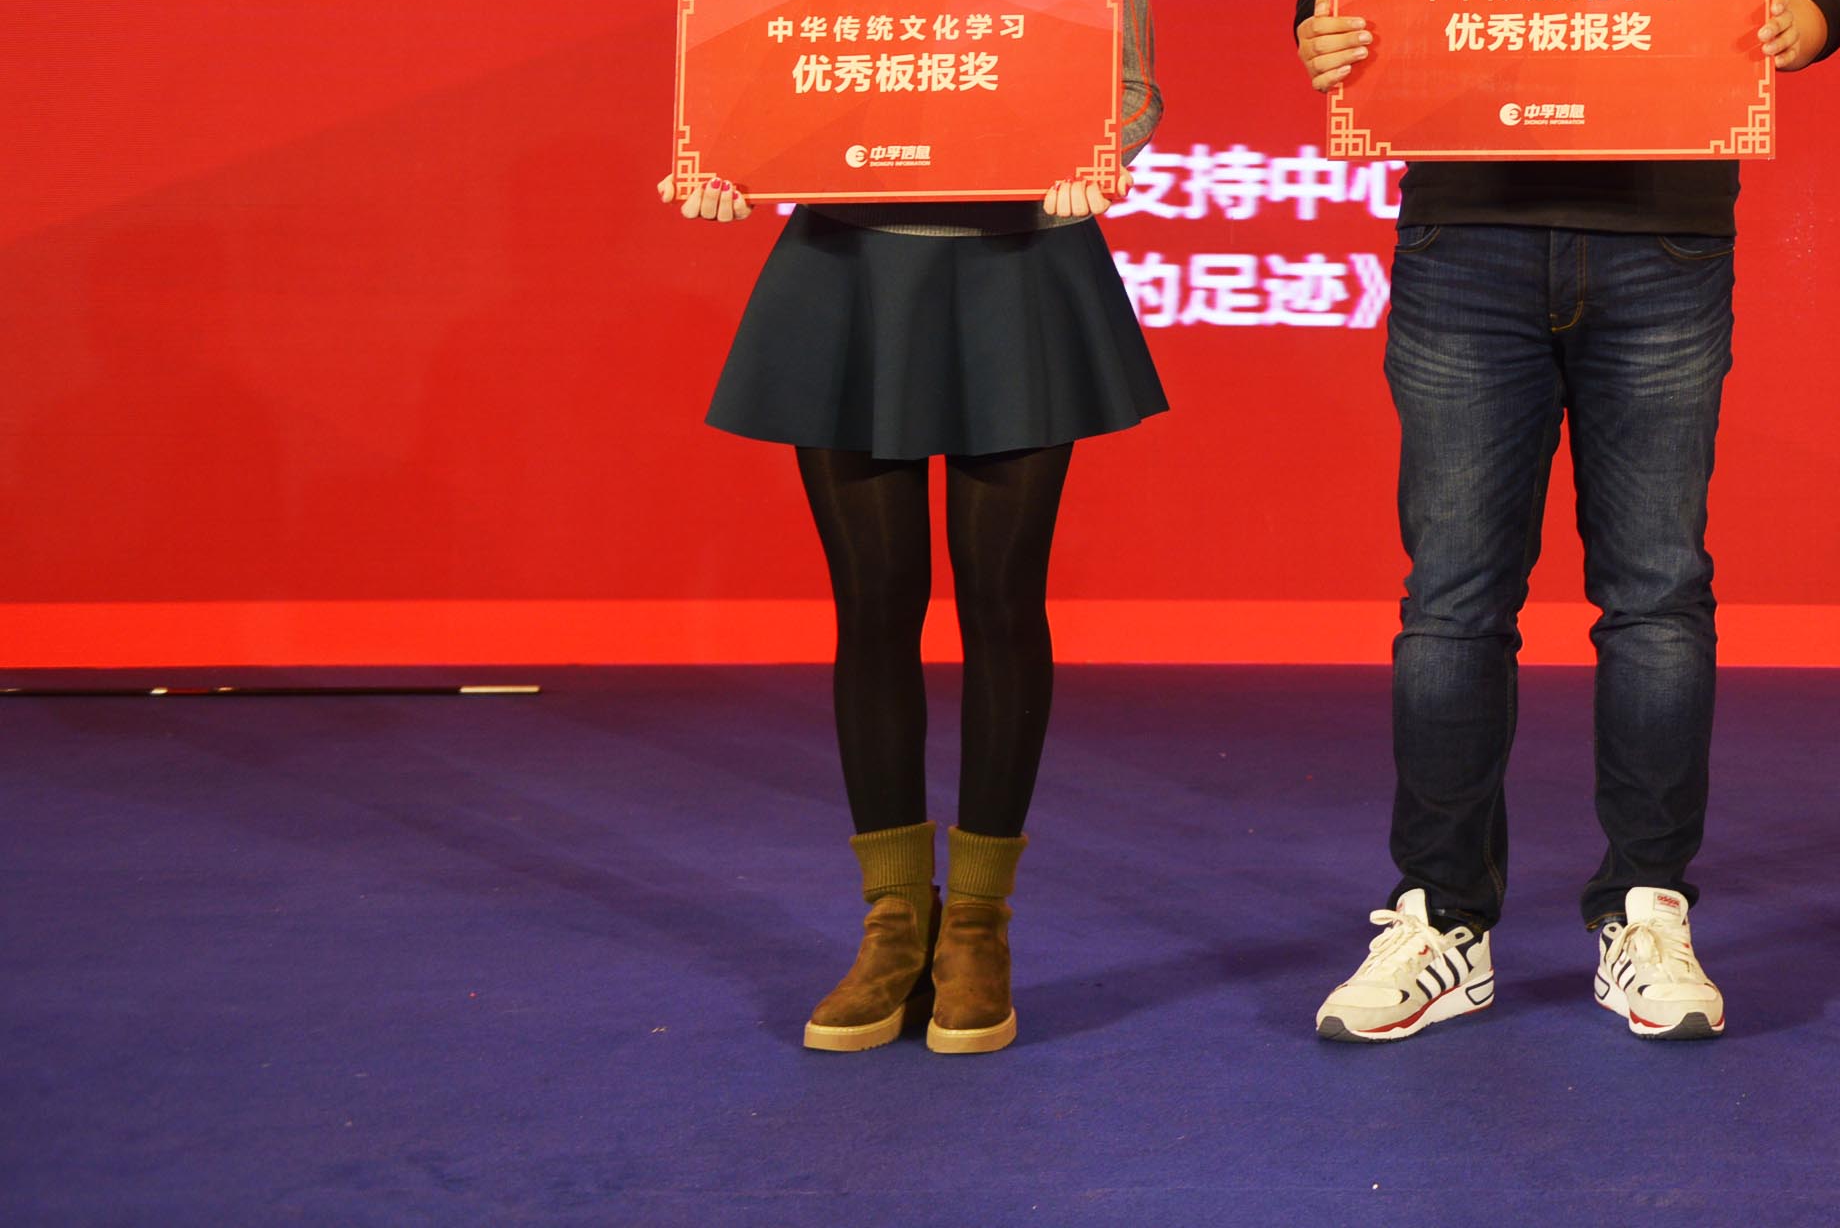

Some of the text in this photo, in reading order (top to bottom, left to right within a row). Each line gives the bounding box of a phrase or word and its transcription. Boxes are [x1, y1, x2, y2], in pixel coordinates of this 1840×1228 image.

[767, 13, 1025, 44] 中华传统文化学习
[1444, 11, 1652, 52] 优秀板报奖
[791, 52, 999, 94] 优秀板报奖
[1524, 103, 1585, 119] 中孚信息
[870, 145, 931, 160] 中孚信息
